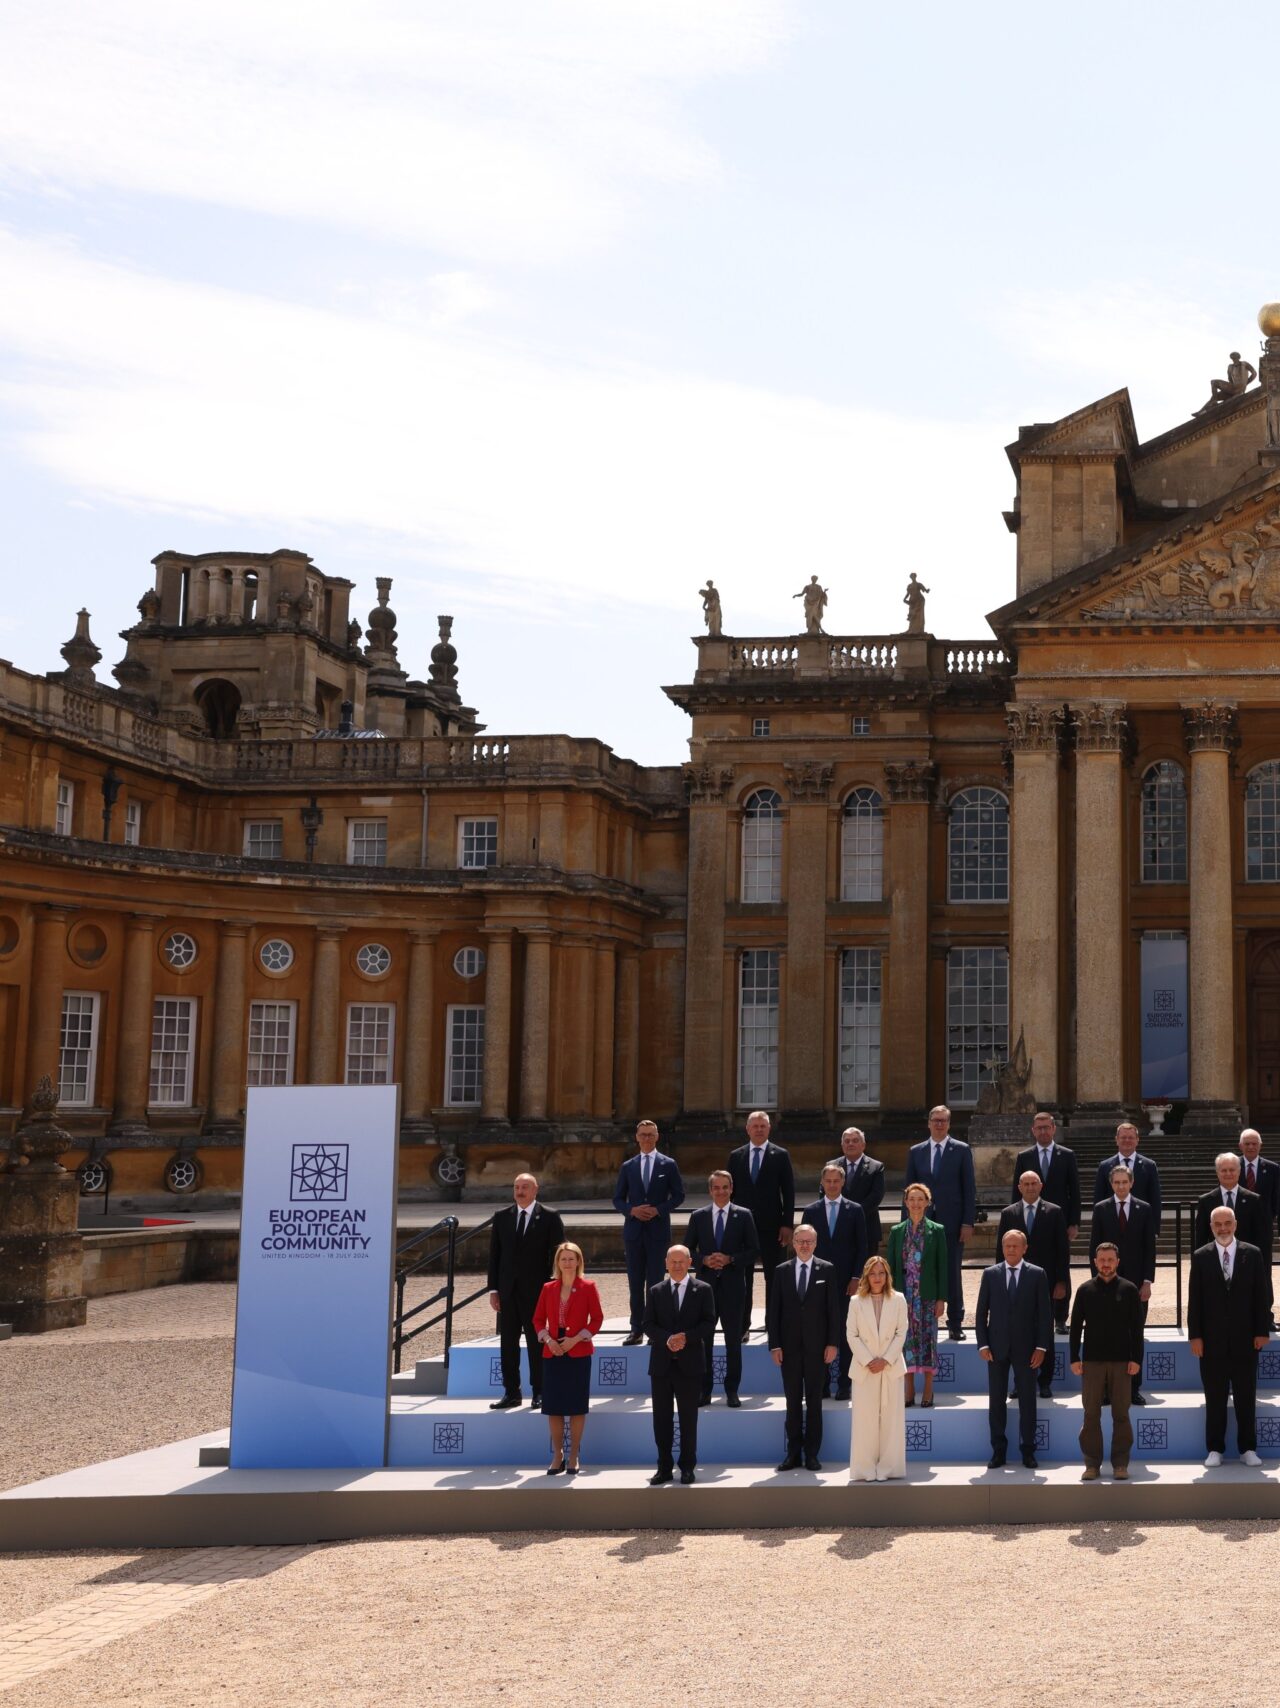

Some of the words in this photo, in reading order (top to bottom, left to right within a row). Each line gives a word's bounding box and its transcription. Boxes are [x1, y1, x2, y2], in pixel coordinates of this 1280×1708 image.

[269, 1210, 366, 1222] EUROPEAN
[272, 1223, 361, 1236] POLITICAL
[261, 1237, 371, 1250] COMMUNITY
